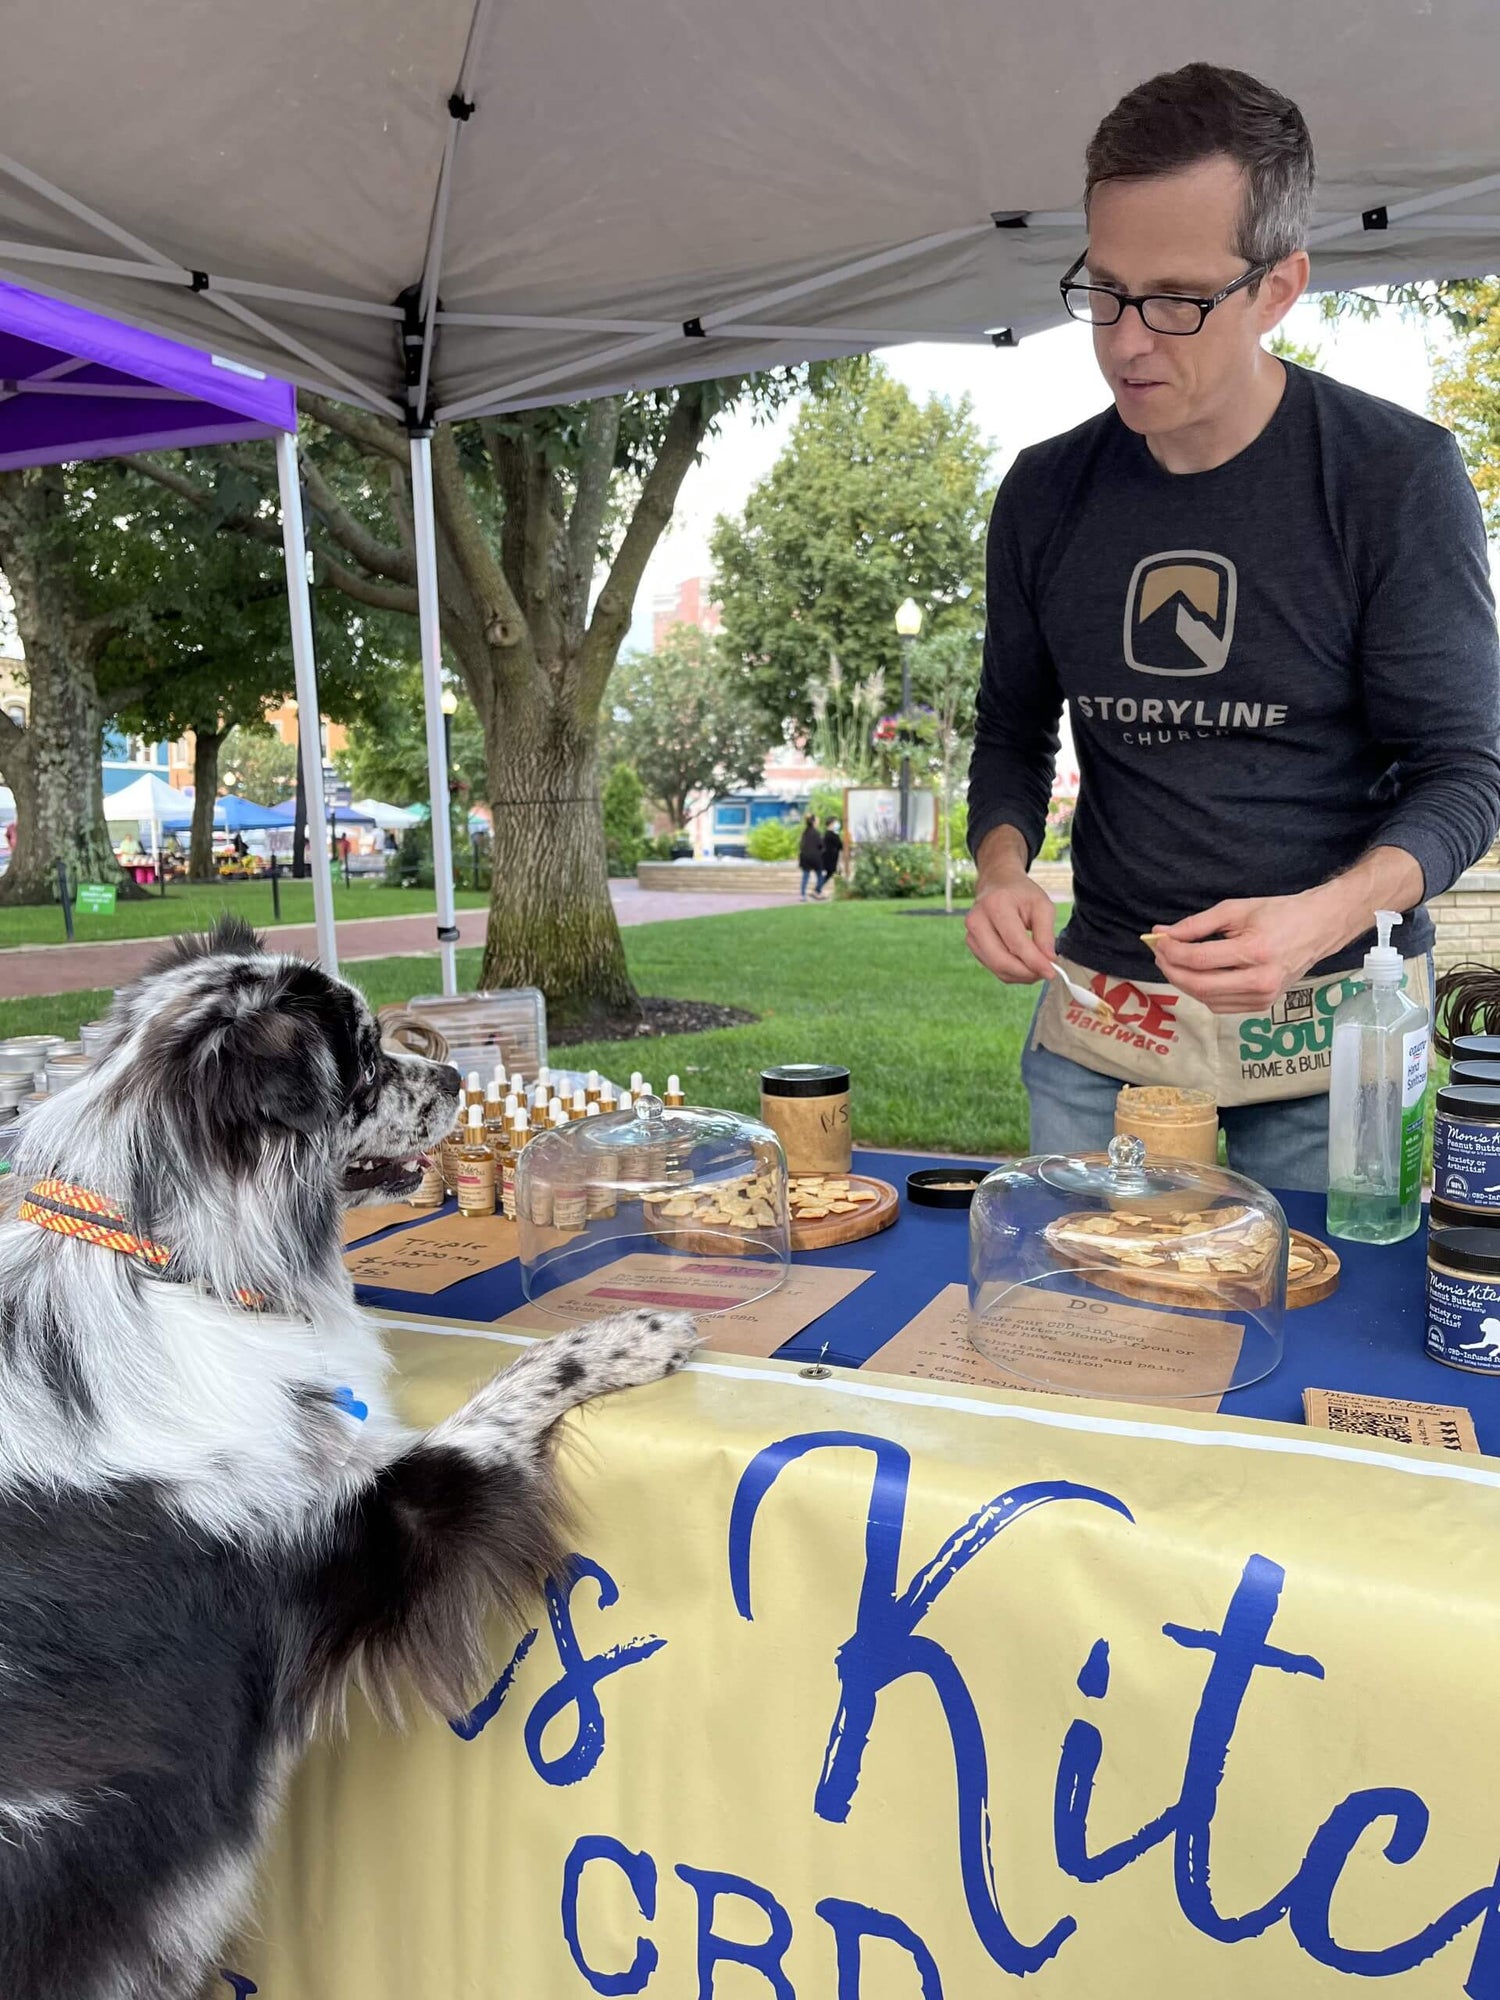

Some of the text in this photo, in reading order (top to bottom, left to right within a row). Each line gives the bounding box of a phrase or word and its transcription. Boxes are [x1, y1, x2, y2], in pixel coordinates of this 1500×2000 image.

[1077, 696, 1289, 728] STORYLINE
[1066, 1008, 1170, 1056] Hardware
[1239, 1017, 1335, 1061] Sou
[1241, 1051, 1332, 1080] HOME & BUIL
[1408, 1062, 1420, 1077] Hand
[1447, 1138, 1473, 1150] Peanut
[1475, 1144, 1500, 1152] Butte
[406, 1238, 488, 1250] Triple
[1430, 1271, 1466, 1296] Mom's
[1467, 1285, 1500, 1302] Kitc
[1066, 1299, 1109, 1314] DO
[1451, 1295, 1483, 1308] Butter
[1020, 1331, 1057, 1342] have
[1047, 1321, 1145, 1343] CBD-infused
[994, 1345, 1104, 1368] inflammation
[1140, 1342, 1170, 1353] you
[1175, 1349, 1195, 1357] or
[1447, 1348, 1492, 1362] CBD-Infused
[942, 1353, 979, 1365] want
[1054, 1349, 1099, 1361] aches
[1103, 1356, 1133, 1366] and
[1136, 1360, 1185, 1373] pains
[928, 1372, 946, 1381] to
[729, 1429, 1500, 2000] Kitc
